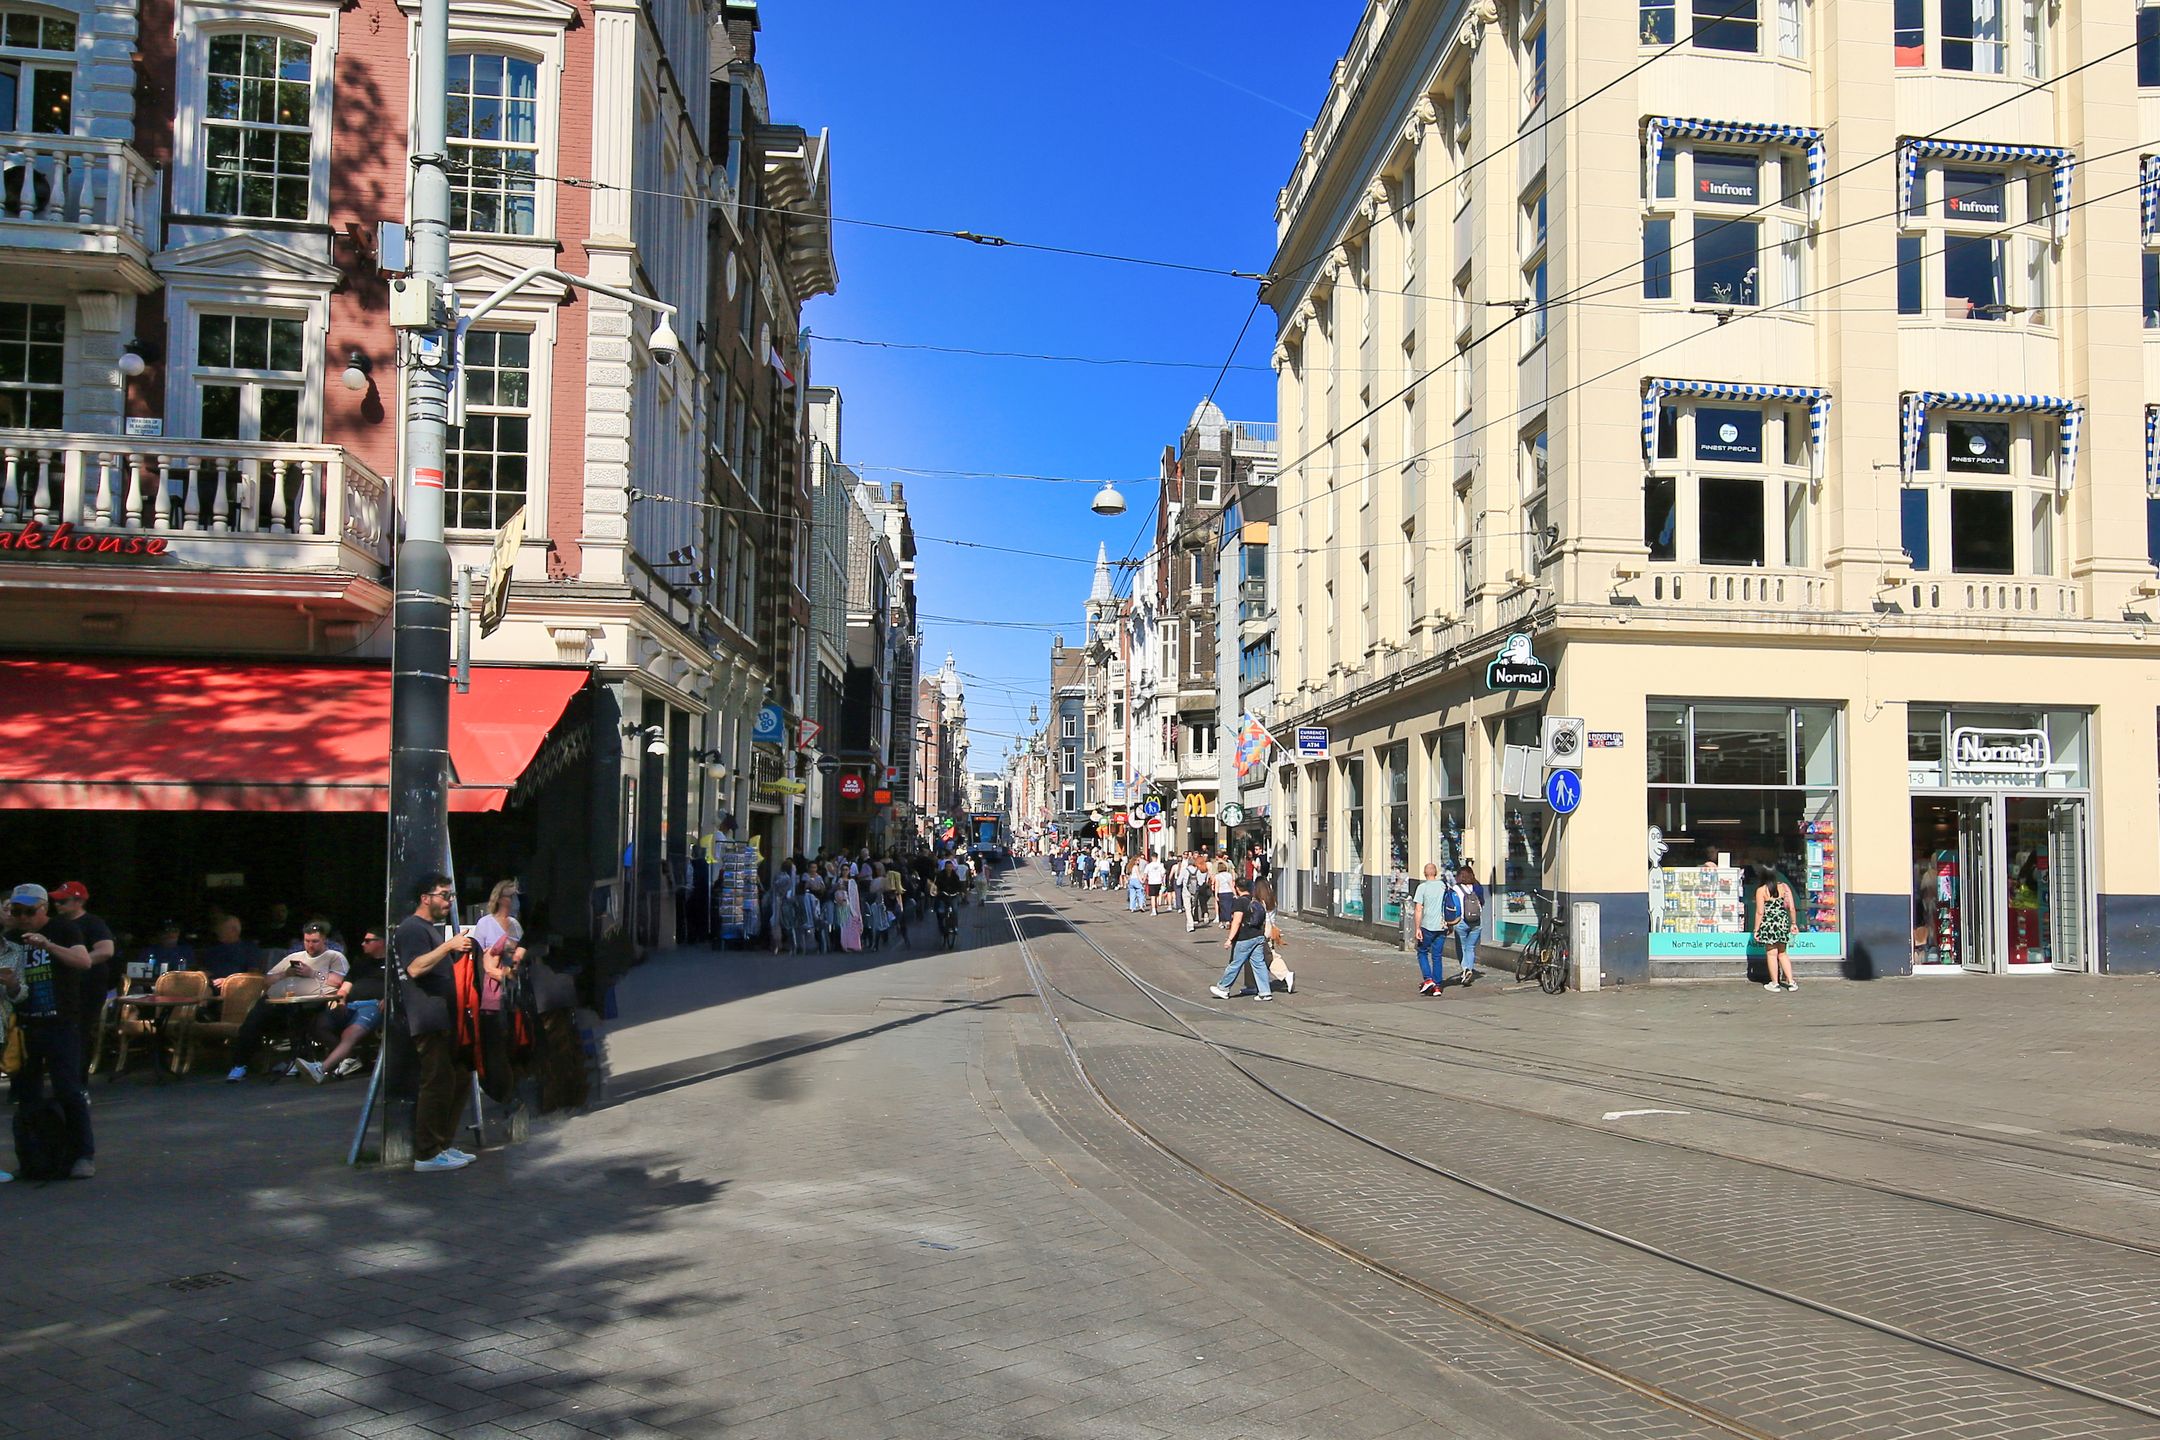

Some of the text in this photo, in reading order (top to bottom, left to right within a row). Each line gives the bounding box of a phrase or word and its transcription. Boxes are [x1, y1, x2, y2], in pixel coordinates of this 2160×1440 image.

[1710, 183, 1752, 196] Infront
[1959, 201, 1999, 214] Infront
[1496, 667, 1542, 683] Normal
[758, 711, 769, 720] to
[760, 719, 774, 731] go
[1962, 735, 2039, 762] Normal
[1672, 940, 1702, 948] Normale
